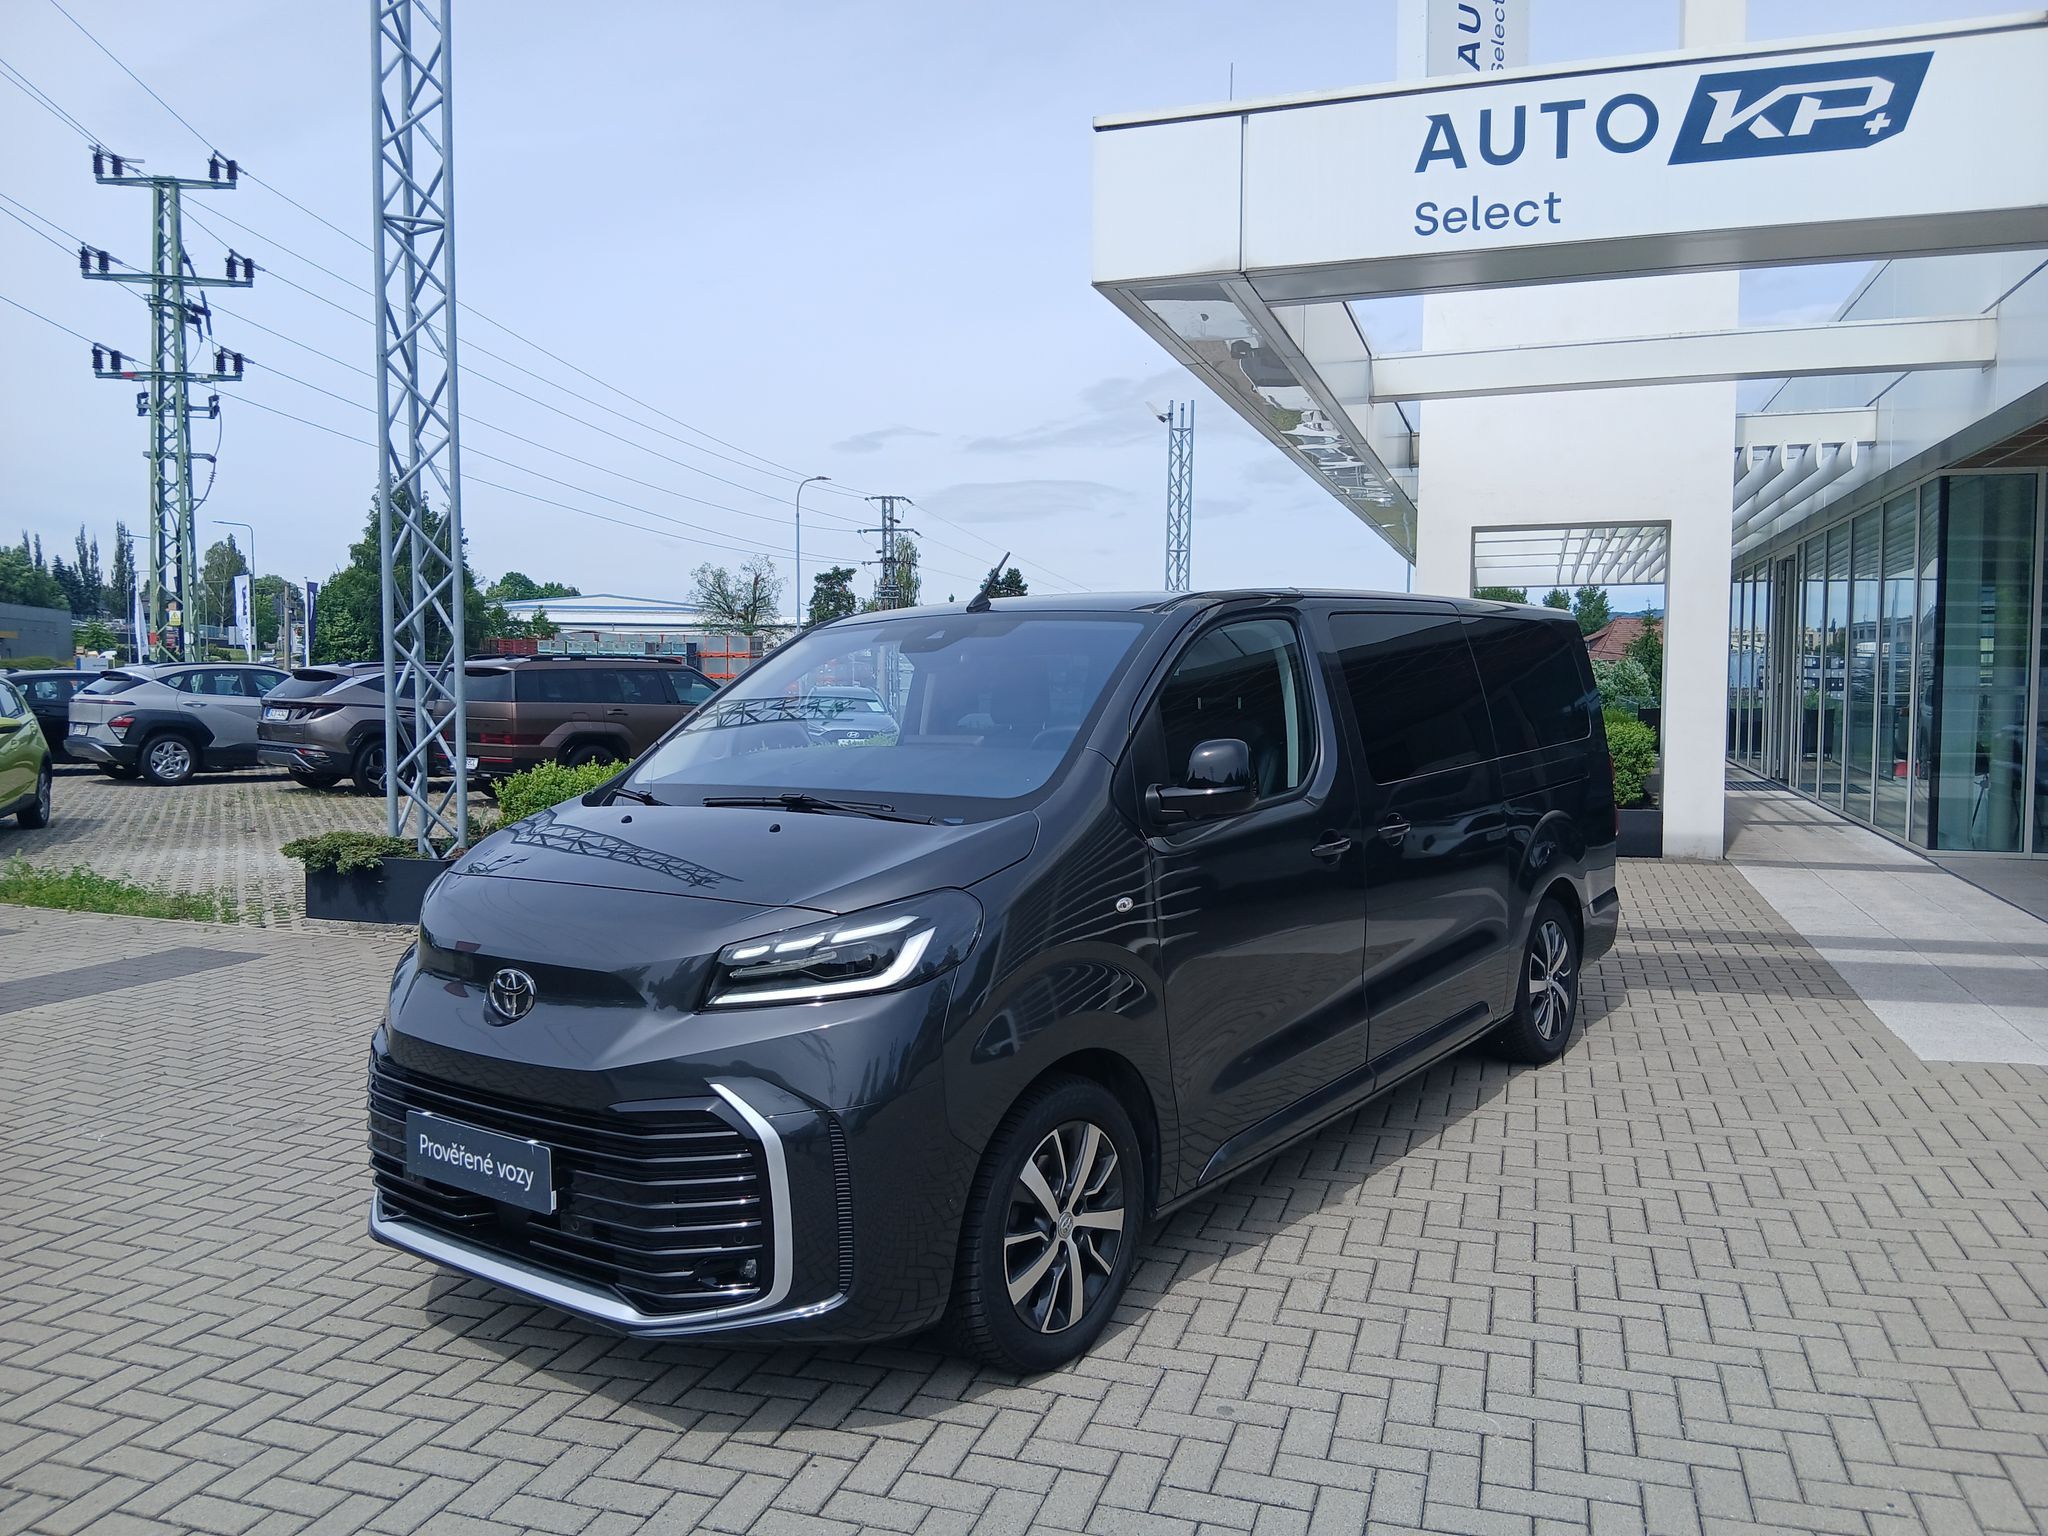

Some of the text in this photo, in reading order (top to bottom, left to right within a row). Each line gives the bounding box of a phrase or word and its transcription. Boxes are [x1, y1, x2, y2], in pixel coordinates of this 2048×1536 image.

[1415, 94, 1659, 173] AUTO
[1415, 192, 1561, 236] Select
[419, 1134, 534, 1191] Prověřené vozy
